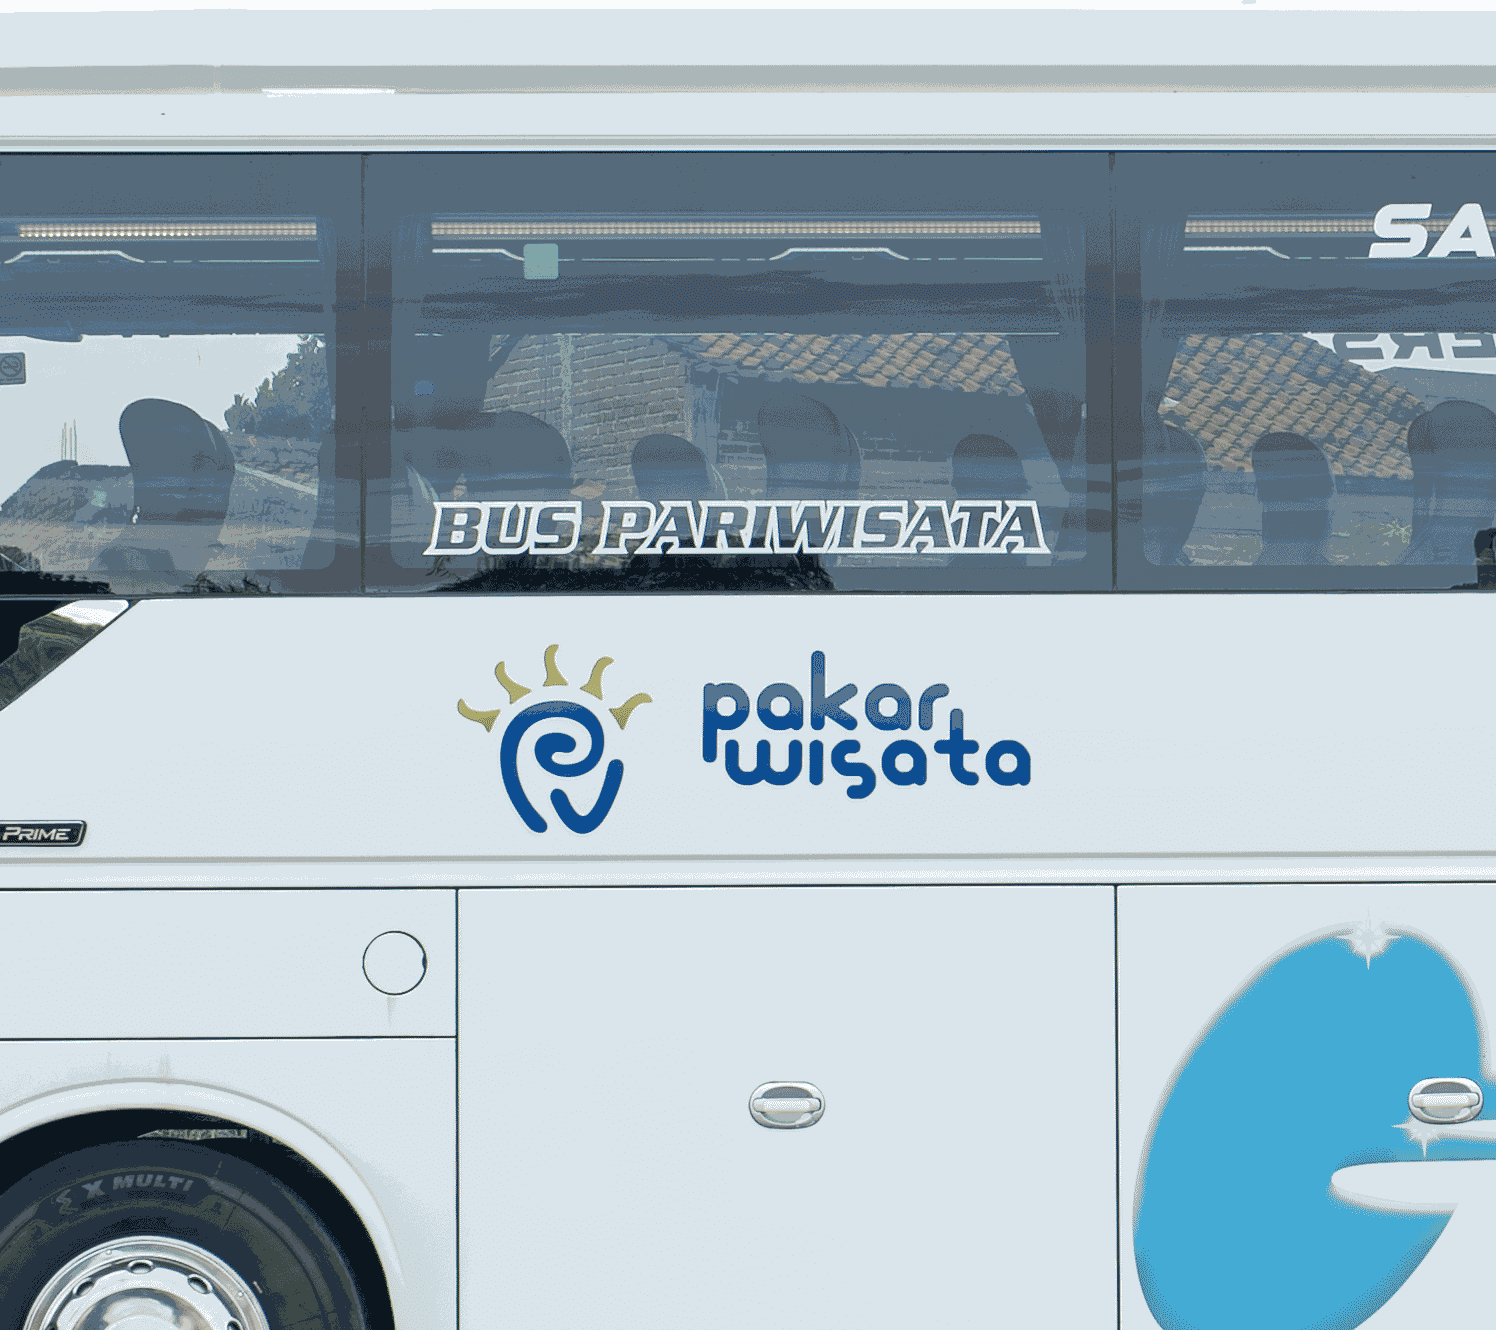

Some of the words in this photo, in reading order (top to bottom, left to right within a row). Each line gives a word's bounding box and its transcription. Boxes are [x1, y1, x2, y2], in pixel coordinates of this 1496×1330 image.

[423, 501, 582, 556] BUS
[594, 500, 1052, 555] PARIWISATA
[703, 650, 951, 763] pakar
[725, 709, 1032, 800] wisata
[112, 1173, 195, 1192] MULTI
